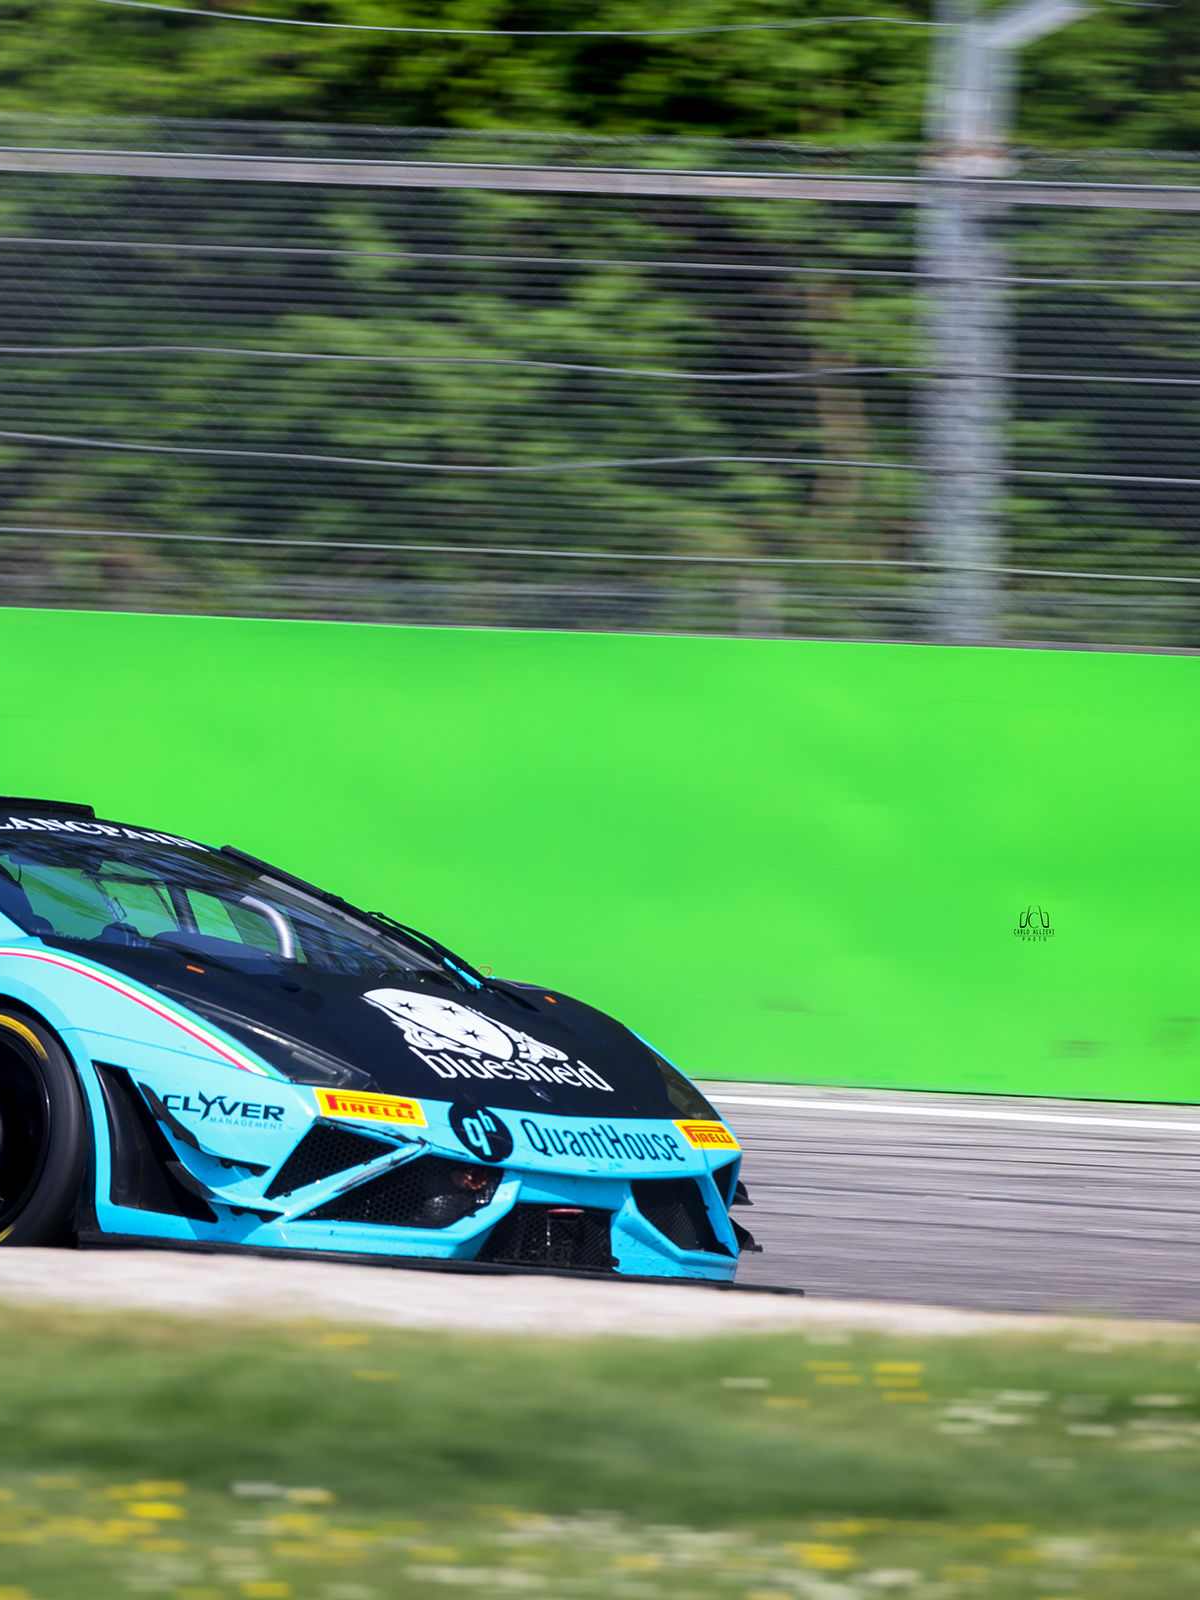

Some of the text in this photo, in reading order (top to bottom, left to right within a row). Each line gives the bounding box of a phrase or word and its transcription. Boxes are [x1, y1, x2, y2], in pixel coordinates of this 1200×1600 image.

[408, 1046, 615, 1092] blueshield
[163, 1090, 284, 1121] CLYVER
[325, 1094, 415, 1119] PIRELLI
[210, 1116, 284, 1130] MANAGEMENT
[683, 1125, 734, 1144] PIRELLI
[520, 1118, 686, 1162] QuantHouse
